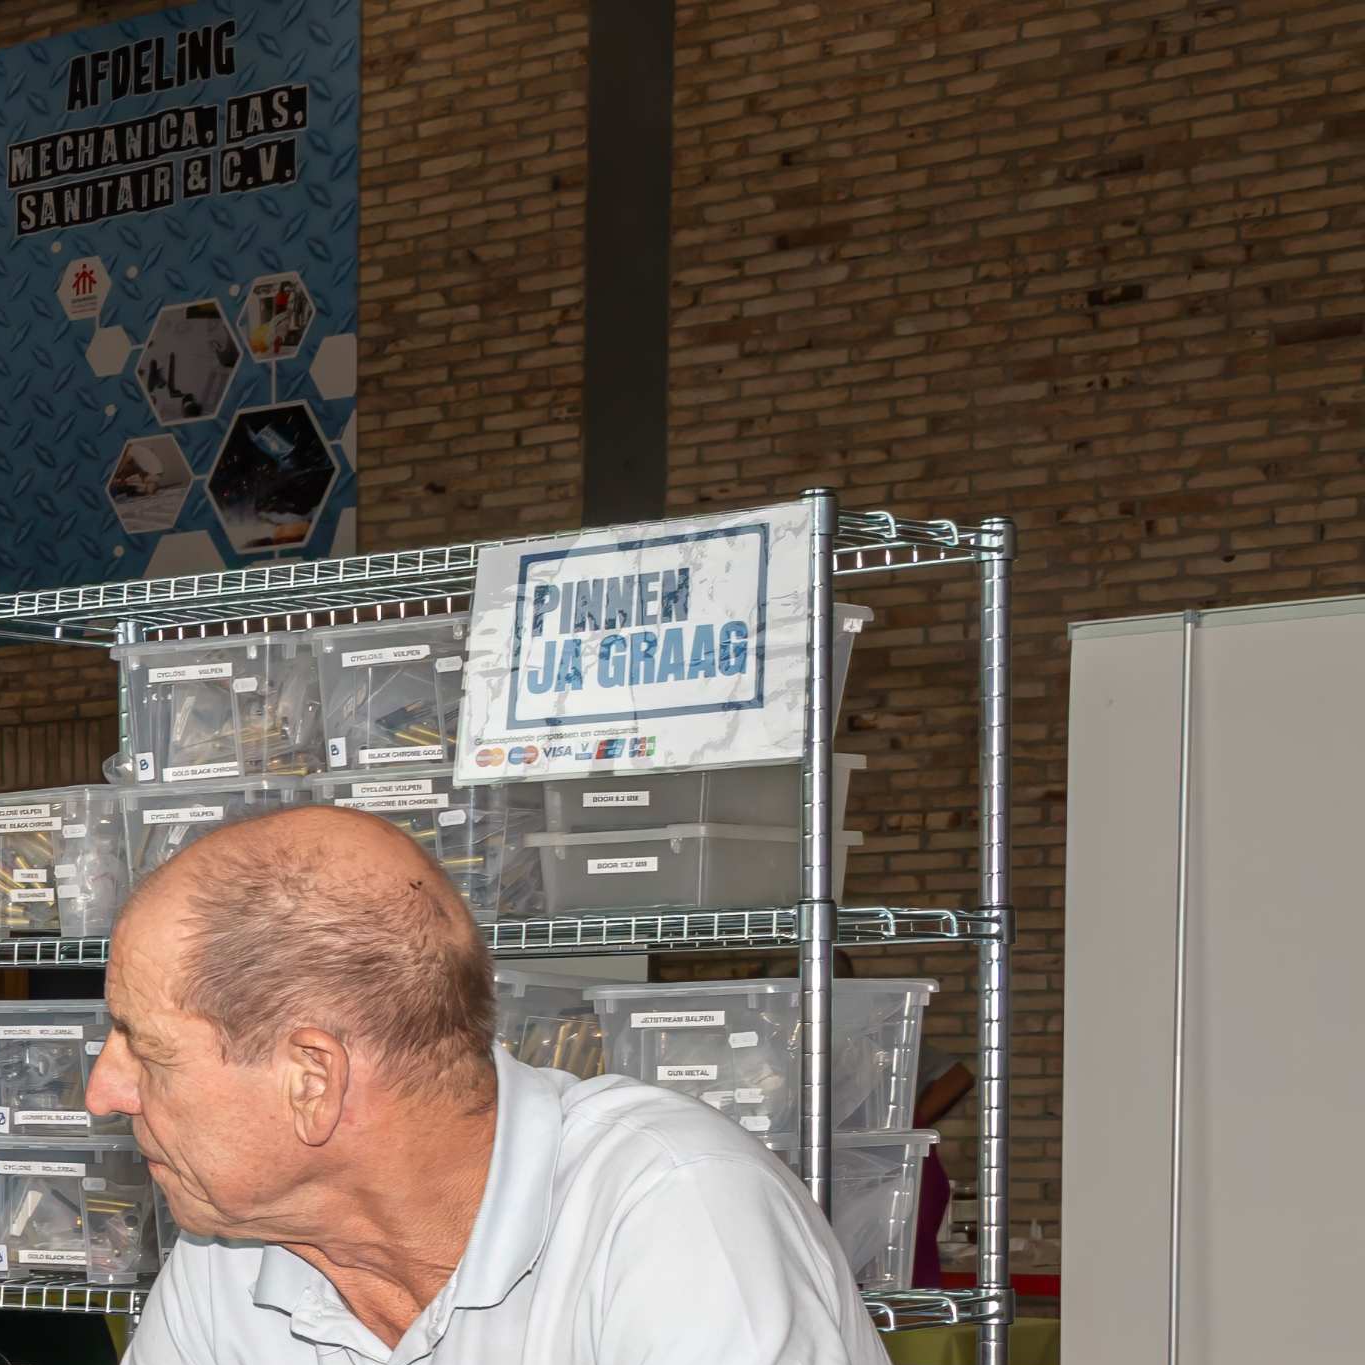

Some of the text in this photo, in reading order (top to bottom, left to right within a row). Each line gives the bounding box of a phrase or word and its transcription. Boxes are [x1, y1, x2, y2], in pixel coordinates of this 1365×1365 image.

[11, 91, 305, 182] MECHANICA, LAS,
[20, 144, 292, 230] SANITAIR & C.V.
[531, 568, 690, 637] PINNEN
[527, 620, 749, 694] JA GRAAG
[542, 745, 572, 758] VISA
